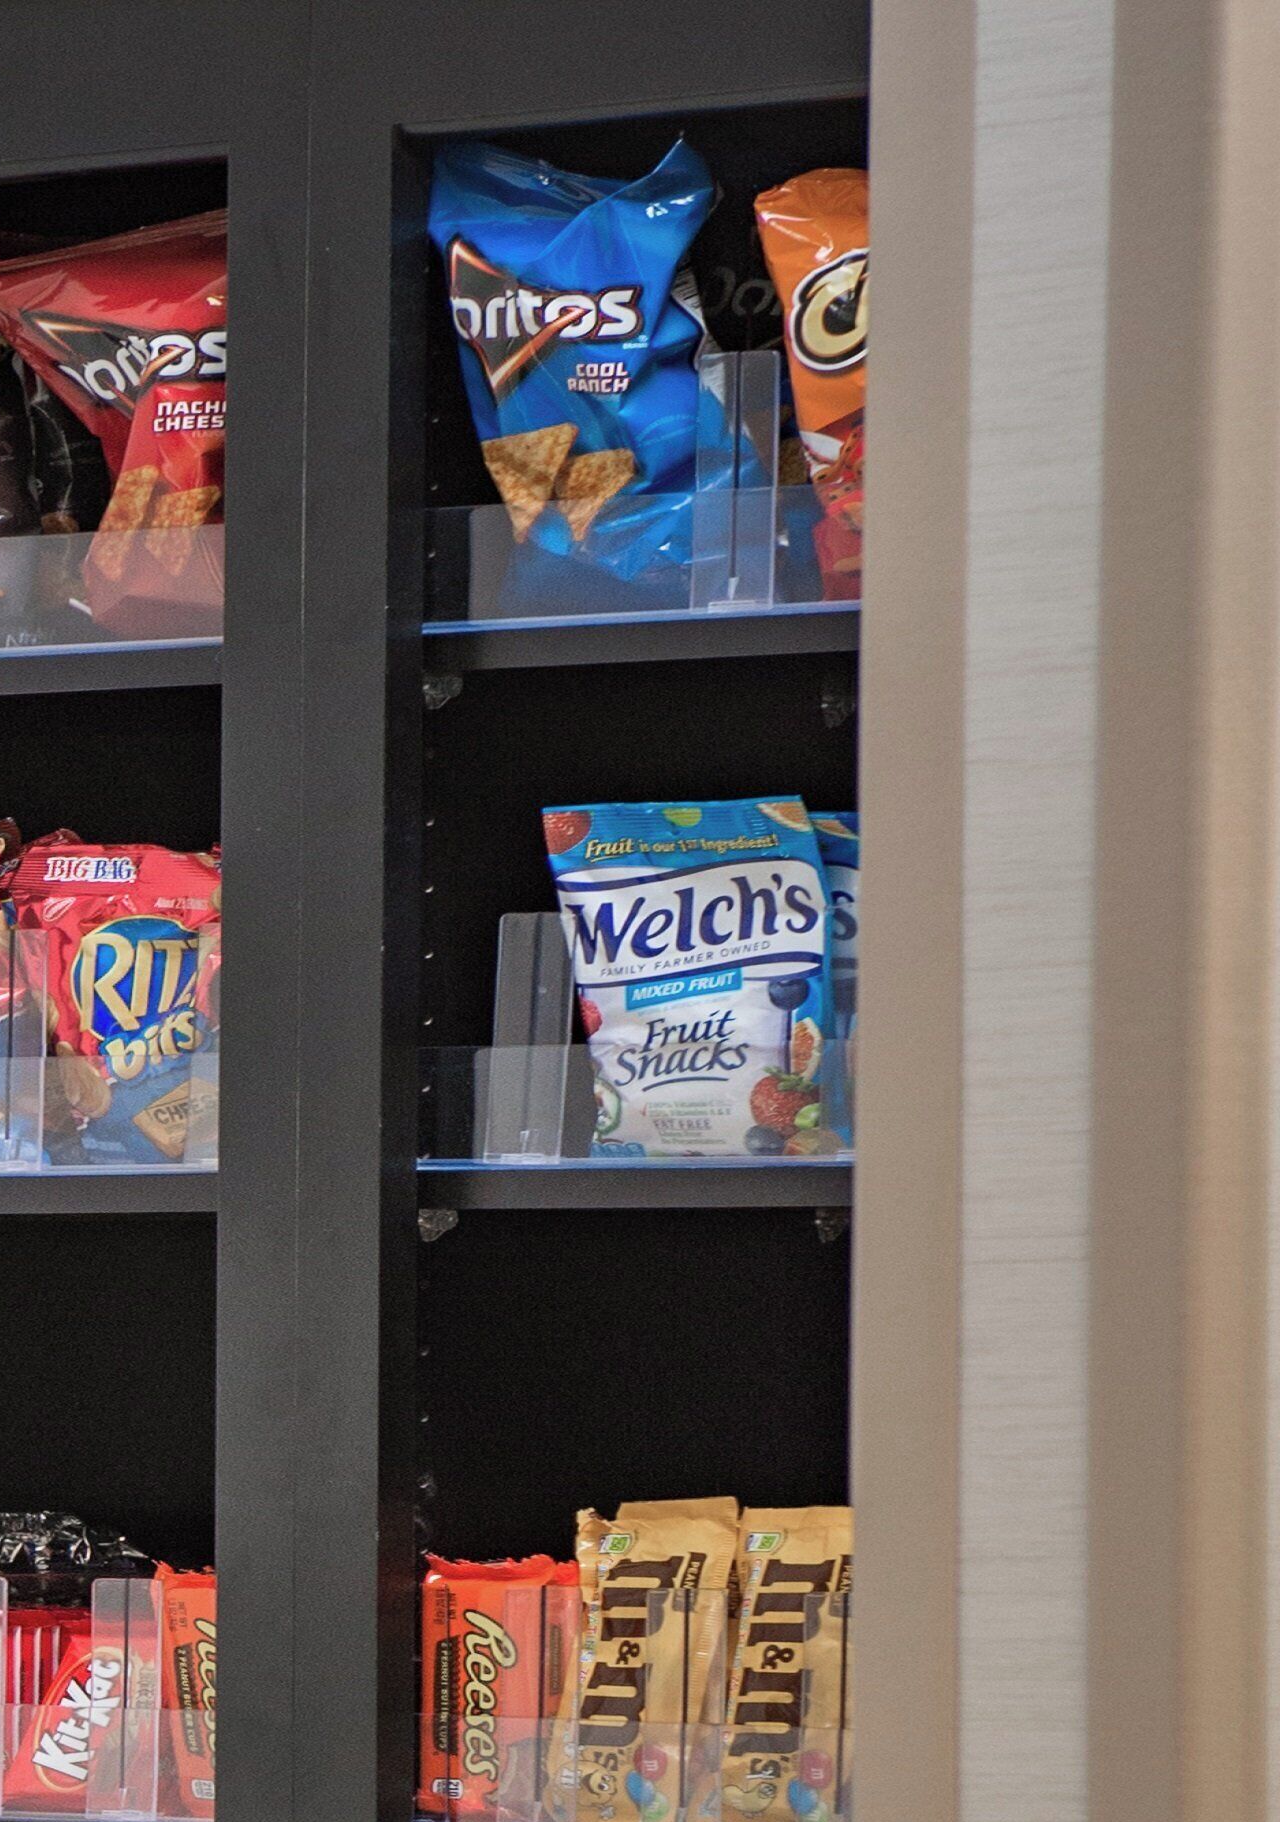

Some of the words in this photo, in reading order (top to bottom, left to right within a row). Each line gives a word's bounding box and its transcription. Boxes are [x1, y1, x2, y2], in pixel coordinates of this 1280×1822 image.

[576, 362, 628, 378] COOL
[567, 378, 630, 393] RANCH
[157, 401, 227, 417] NACH
[153, 415, 225, 433] CHEES
[585, 837, 634, 862] Fruit
[46, 858, 90, 882] BIG
[92, 859, 136, 881] BAG
[565, 873, 819, 965] Welch's
[600, 963, 646, 977] FAMILY
[653, 952, 715, 970] FARMER
[720, 940, 772, 958] OWNED
[632, 981, 684, 1001] MIXED
[689, 971, 736, 991] FRUIT
[640, 1009, 736, 1053] Fruit
[614, 1037, 750, 1087] Snacks
[463, 1610, 518, 1781] Reese's
